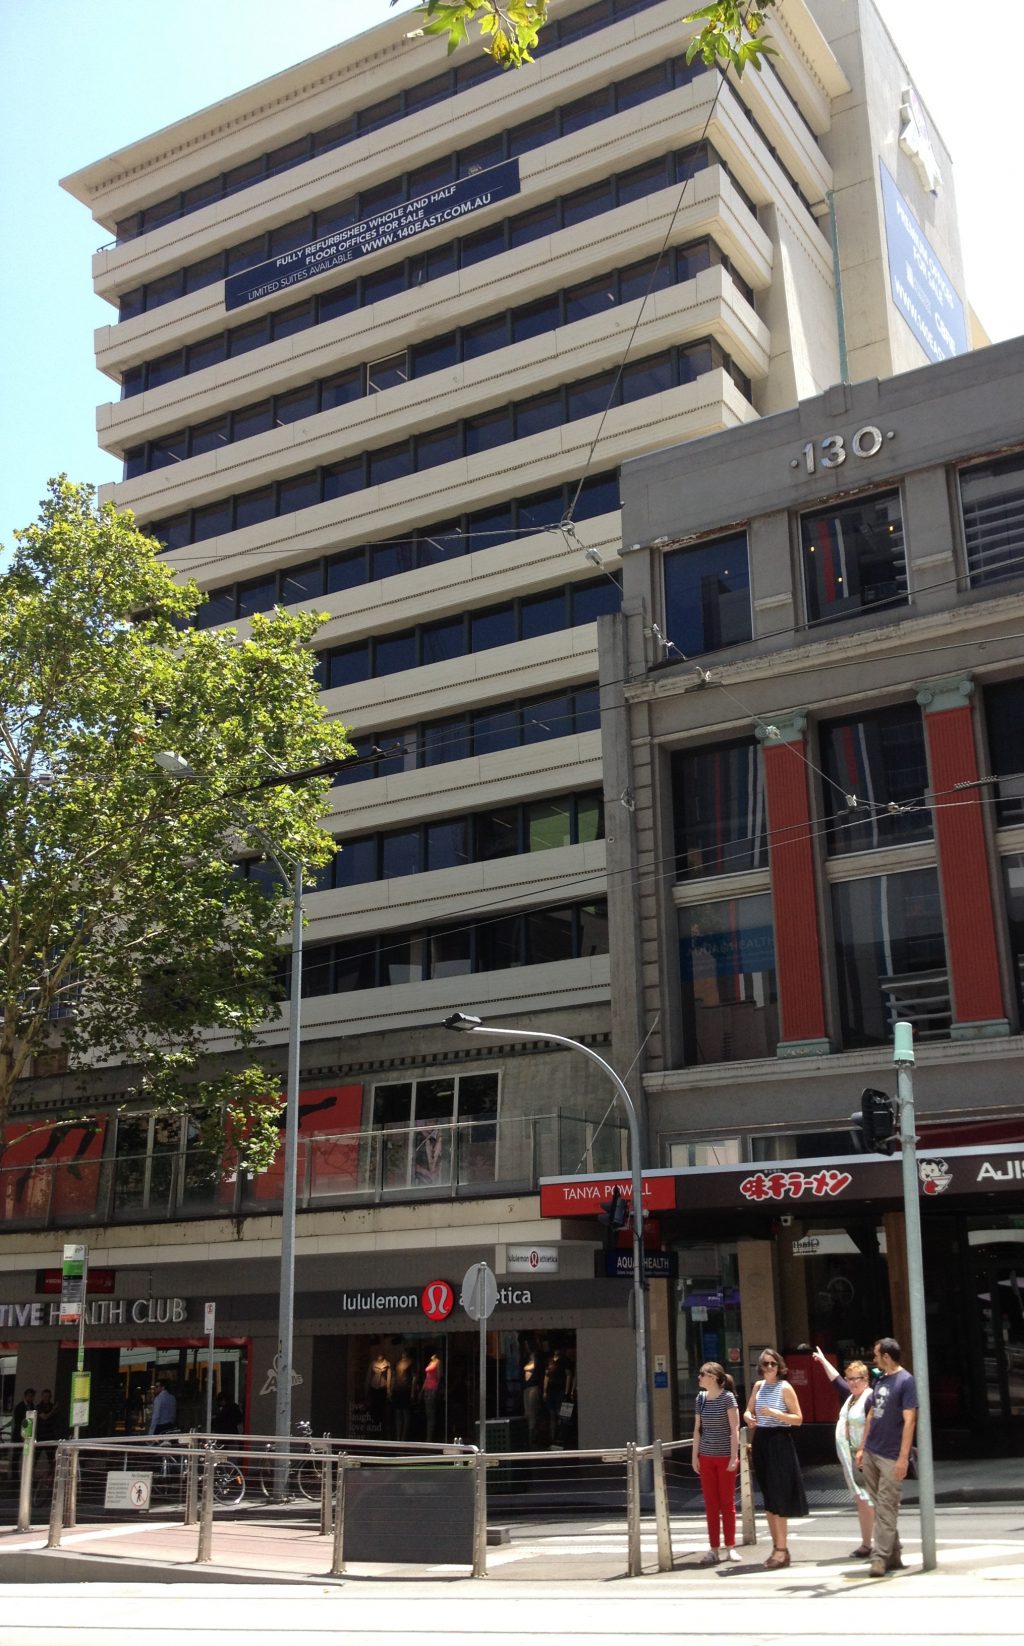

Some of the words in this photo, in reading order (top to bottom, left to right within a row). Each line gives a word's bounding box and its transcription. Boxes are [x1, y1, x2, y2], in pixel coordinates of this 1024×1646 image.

[276, 250, 304, 268] FULLY
[305, 224, 367, 256] REFURBISHED
[369, 209, 404, 228] WHOLE
[406, 198, 429, 214] AND
[431, 186, 457, 203] HALF
[306, 247, 337, 265] FLOOR
[338, 229, 377, 251] OFFICES
[379, 222, 399, 234] FOR
[400, 209, 425, 226] SALE
[248, 281, 279, 300] LIMITED
[280, 269, 308, 287] SUITES
[309, 251, 353, 277] AVAILABLE
[802, 425, 883, 474] 130
[976, 1160, 1024, 1181] AJI
[563, 1187, 601, 1200] TANYA
[132, 1298, 184, 1324] CLUB
[343, 1293, 418, 1311] lululemon
[459, 1287, 531, 1306] aetica
